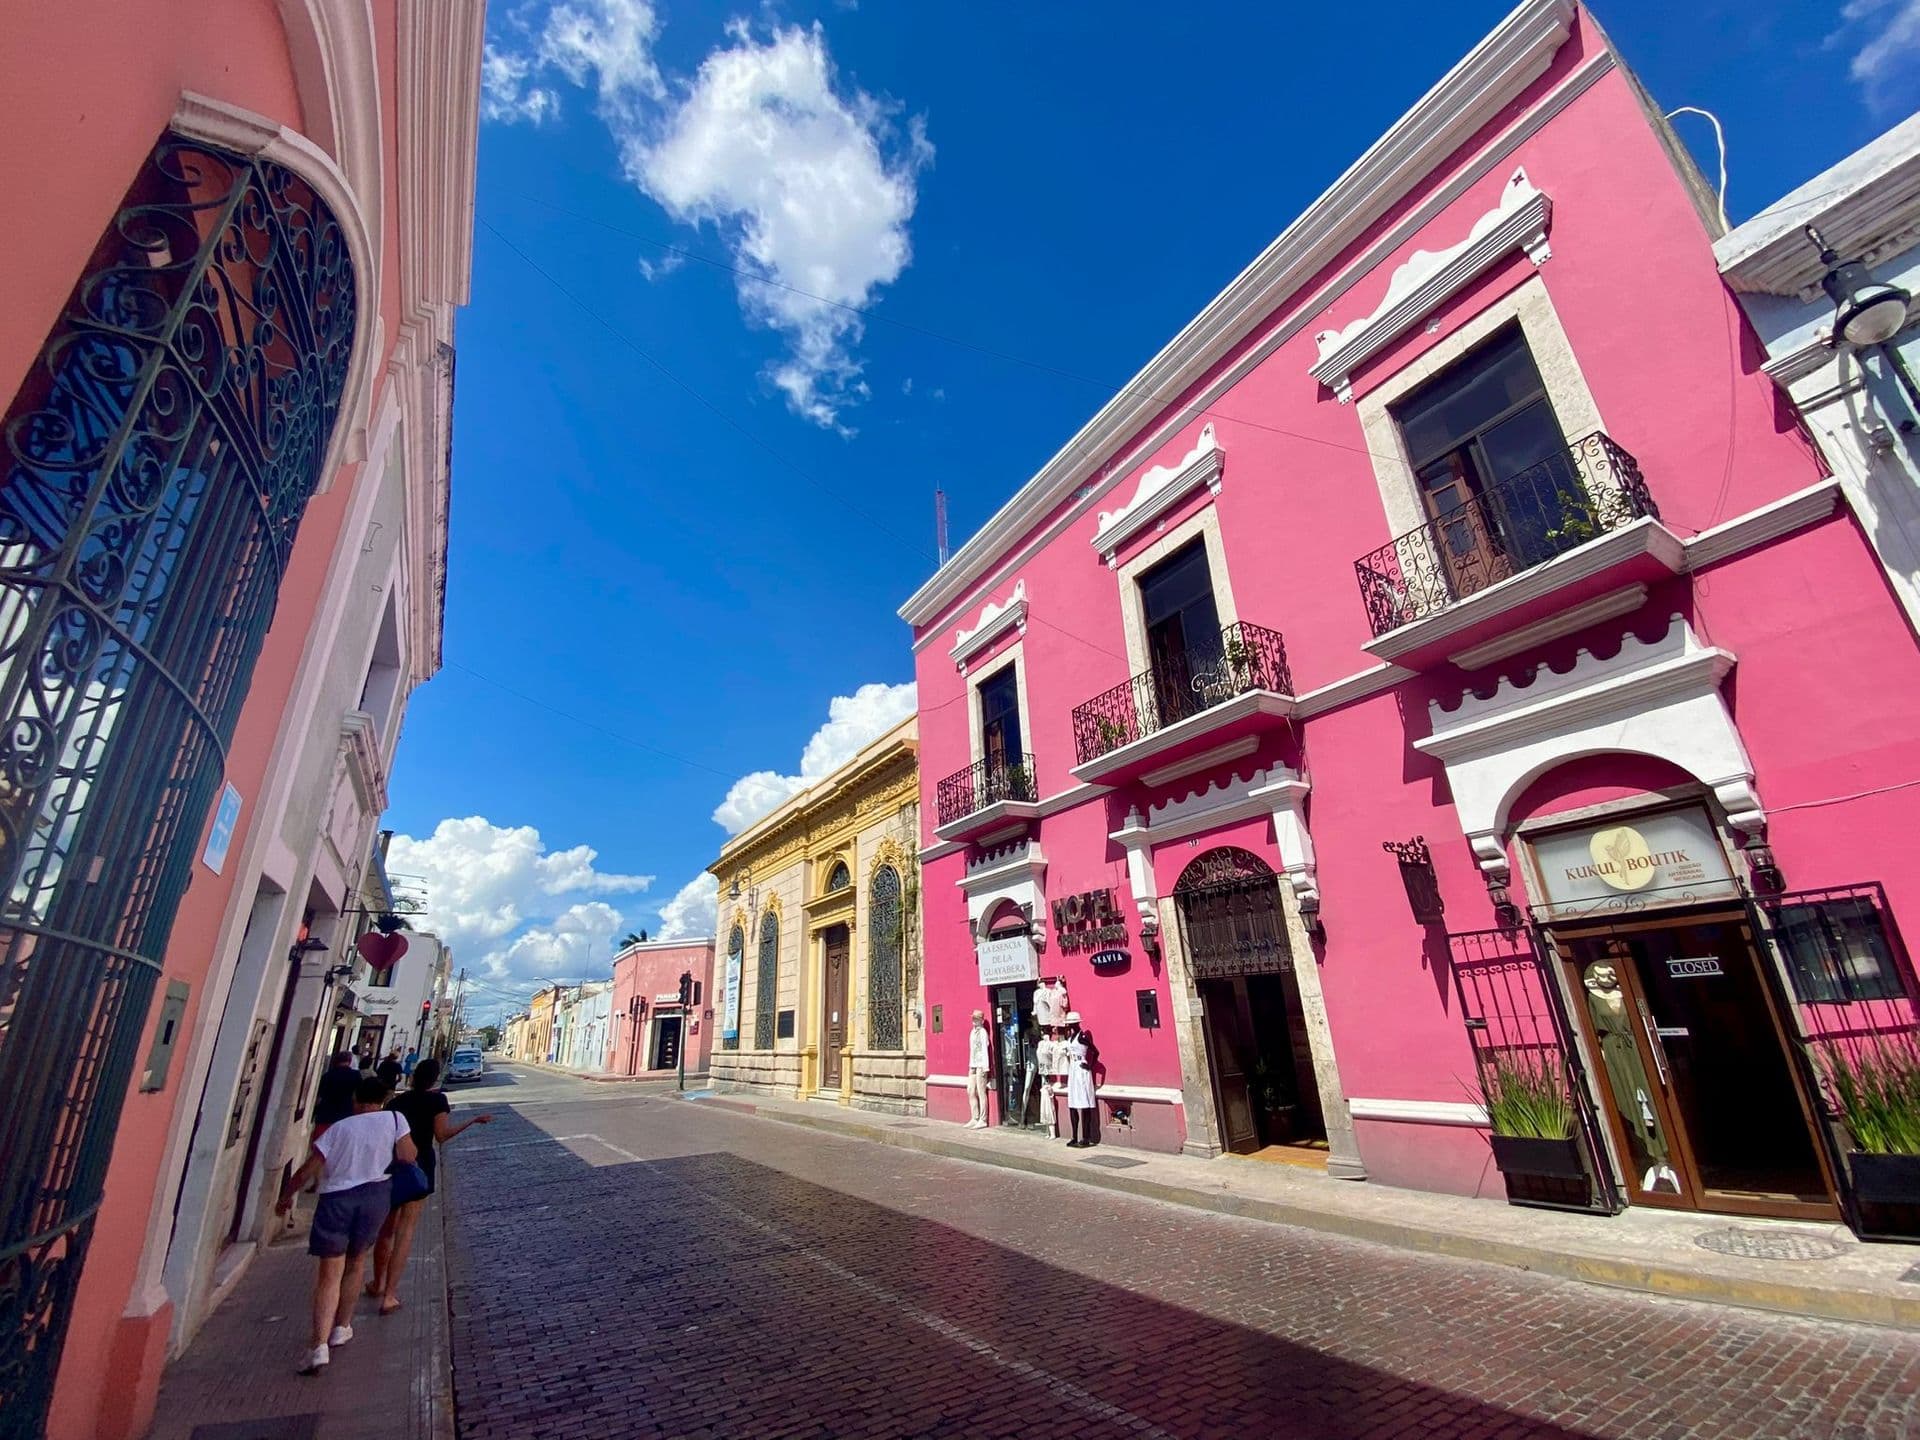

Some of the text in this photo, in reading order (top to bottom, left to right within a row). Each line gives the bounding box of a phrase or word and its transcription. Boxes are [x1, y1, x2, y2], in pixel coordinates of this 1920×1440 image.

[1565, 849, 1691, 881] KUKUL BOUTIK
[1051, 888, 1124, 931] HOTEL
[982, 940, 1022, 954] LA ESENCIA
[992, 954, 1013, 964] DE LA
[1097, 953, 1124, 965] KAVIA
[983, 964, 1026, 977] GUAYABERA
[1670, 960, 1720, 975] CLOSED
